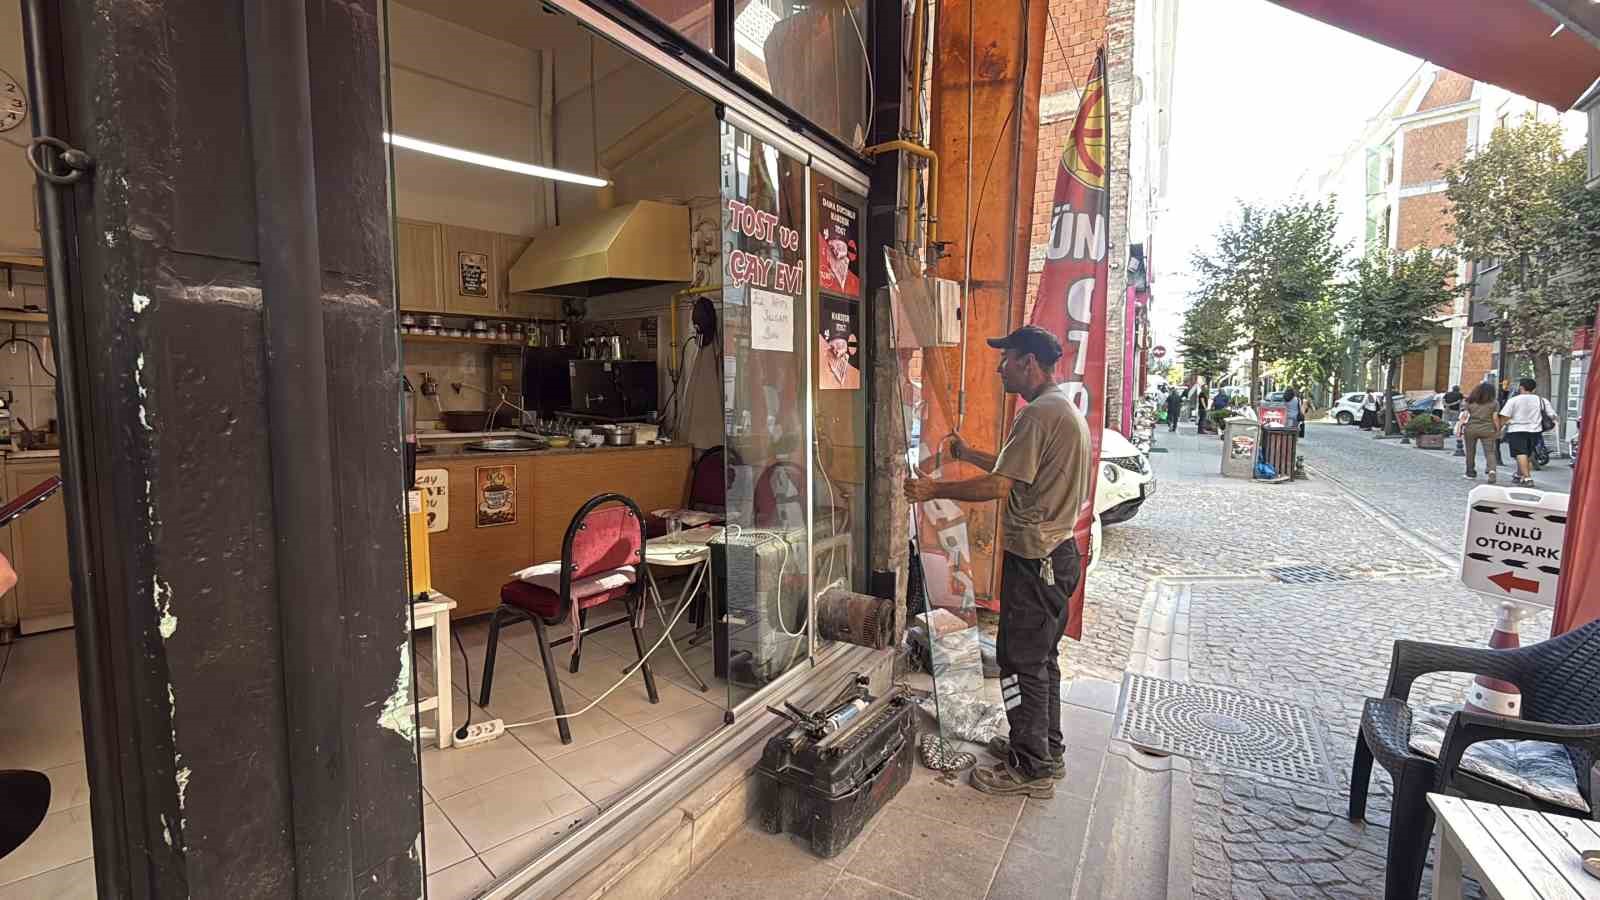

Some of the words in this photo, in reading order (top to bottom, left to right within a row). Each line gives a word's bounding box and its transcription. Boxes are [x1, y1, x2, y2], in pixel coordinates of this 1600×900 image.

[729, 200, 778, 243] TOST
[779, 225, 799, 251] ve
[729, 250, 773, 288] ÇAY
[774, 260, 804, 295] EVİ
[1475, 536, 1560, 561] OTOPARK
[1495, 521, 1542, 541] ÜNLÜ
